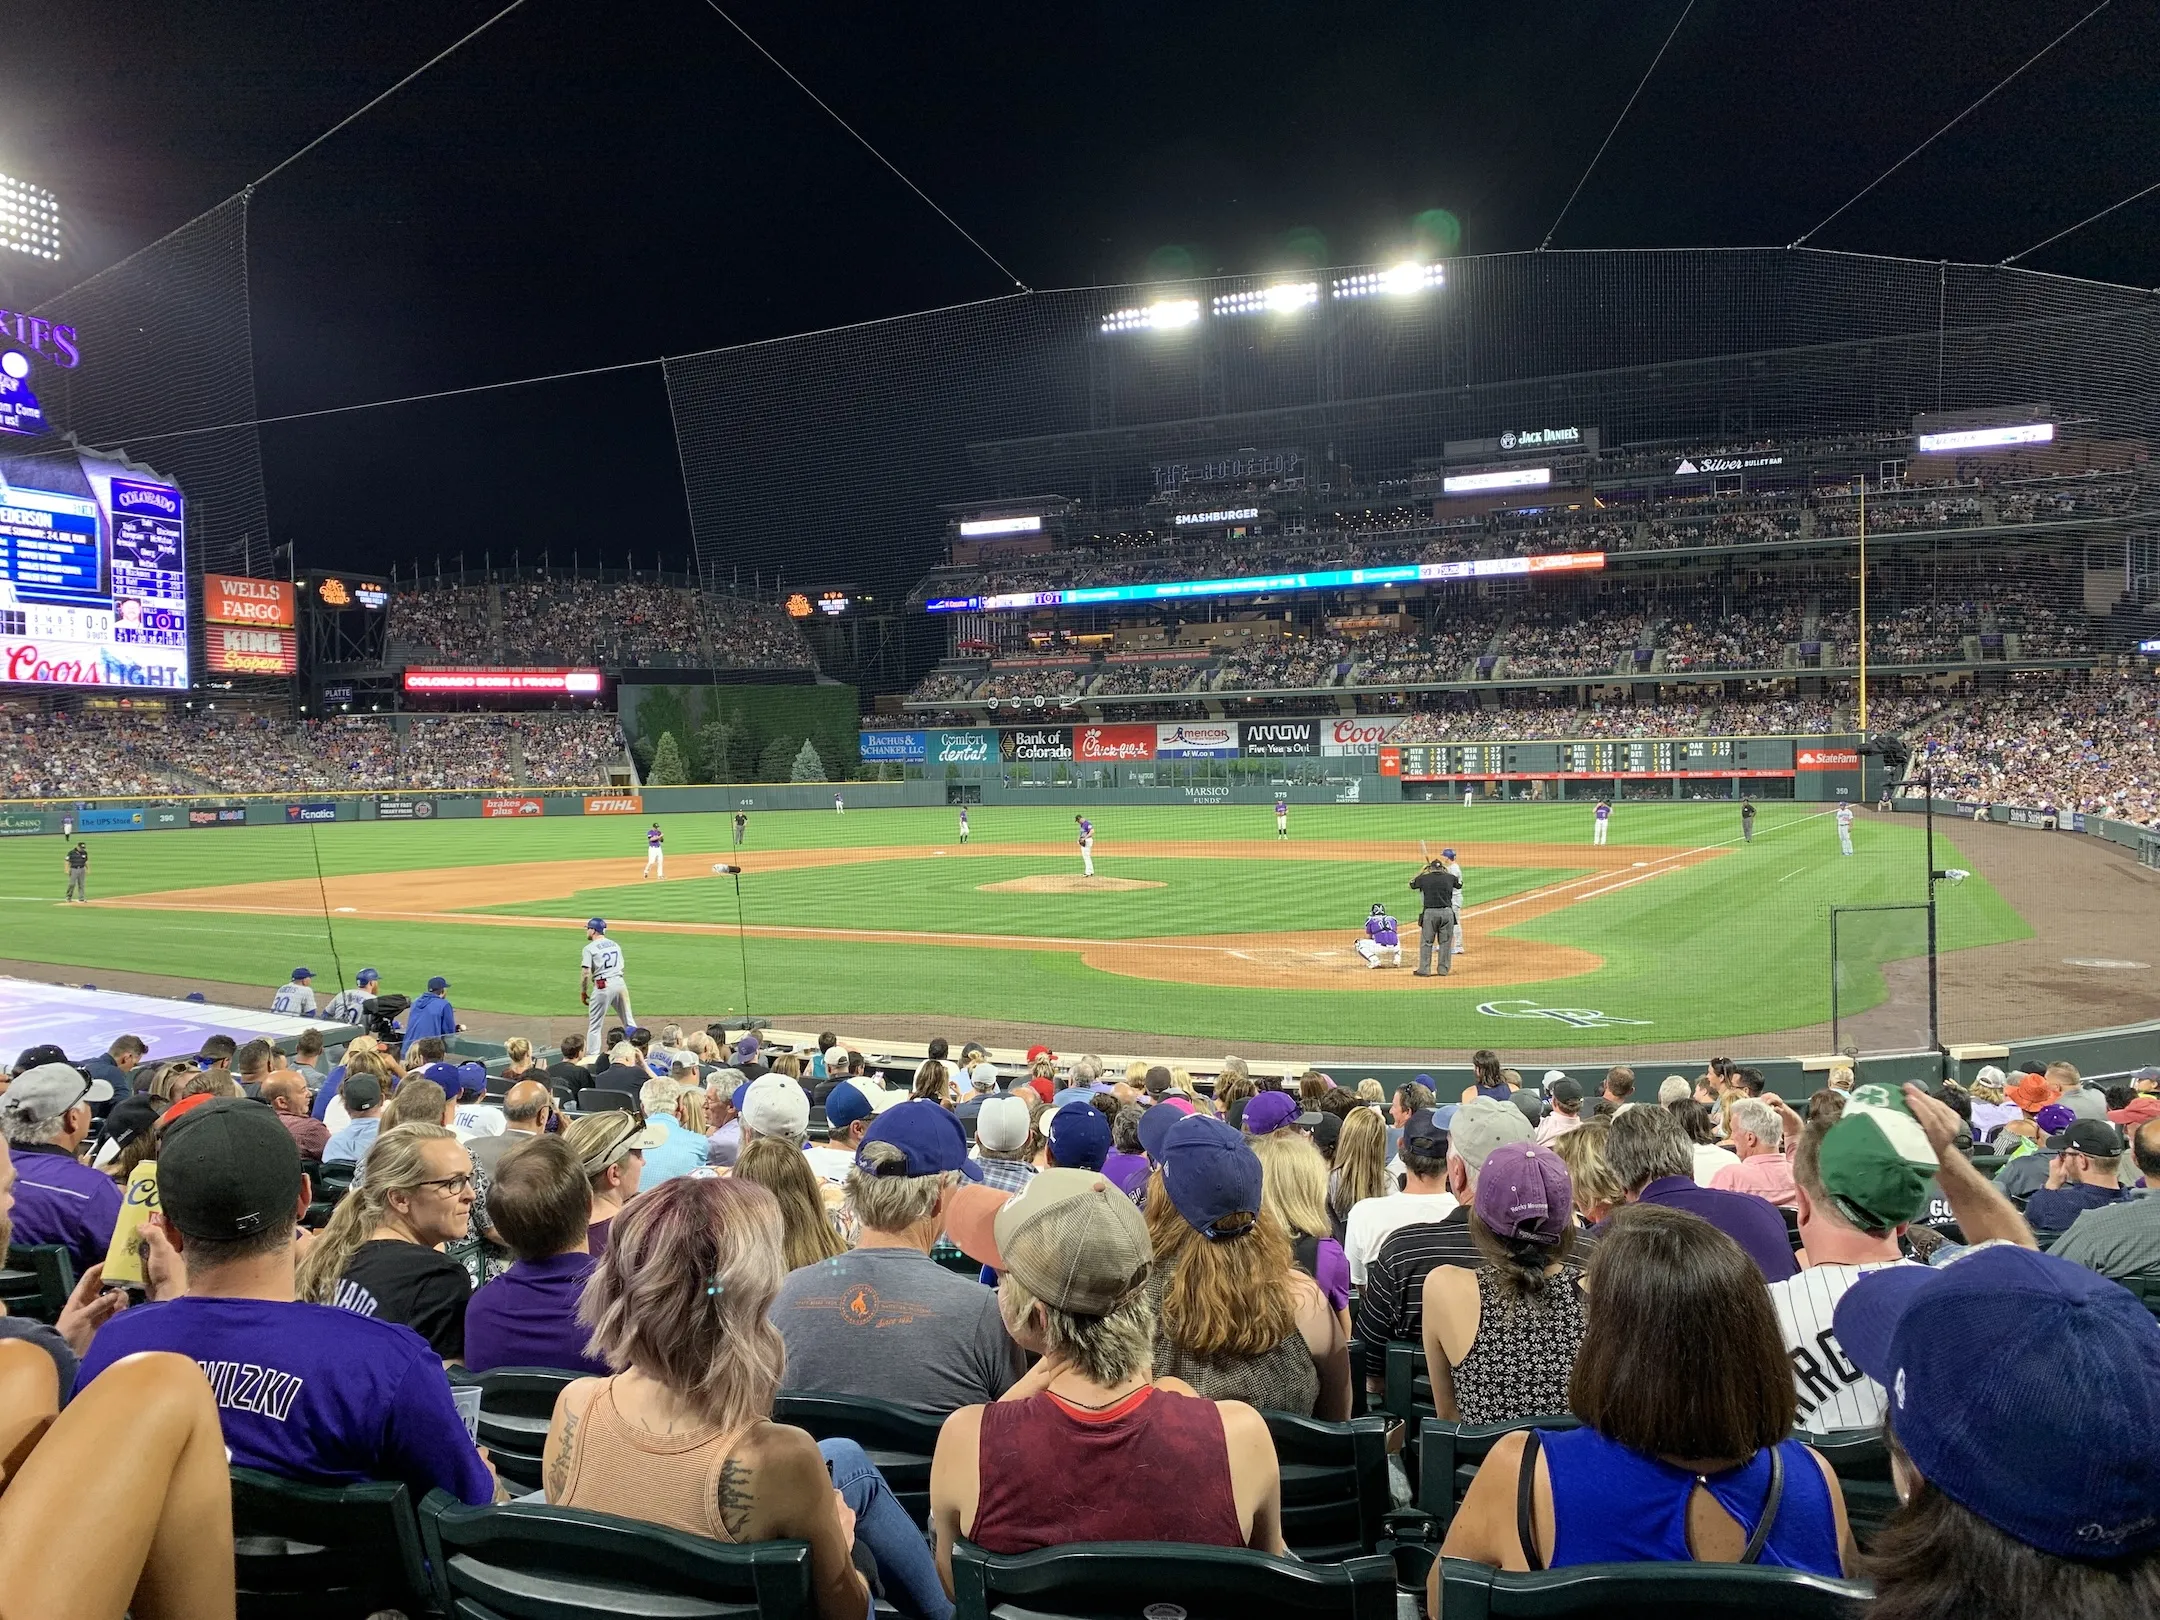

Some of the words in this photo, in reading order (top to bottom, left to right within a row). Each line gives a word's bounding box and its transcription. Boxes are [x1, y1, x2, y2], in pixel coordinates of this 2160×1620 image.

[1518, 431, 1542, 444] JACK
[1544, 427, 1578, 441] DANIEL'S
[1700, 458, 1743, 473] Silver
[1744, 459, 1769, 467] BULLET
[1770, 457, 1782, 465] BAR
[118, 490, 176, 513] COLORADO
[1175, 508, 1258, 525] SMASHBURGER
[220, 580, 280, 601] WELLS
[222, 601, 281, 621] FARGO
[223, 630, 283, 654] KING
[7, 645, 100, 684] Coors
[103, 661, 177, 687] LIGHT
[225, 651, 284, 671] Soopers
[408, 677, 475, 687] COLORADO
[325, 689, 351, 698] PLATTE
[1035, 698, 1043, 706] 17
[941, 732, 985, 746] Comfort
[1016, 731, 1046, 745] Bank
[1048, 730, 1062, 744] of
[1248, 724, 1311, 741] ARROW
[868, 735, 904, 746] BACHUS
[905, 735, 916, 745] &
[1083, 735, 1149, 759] Chick-fil-A
[860, 744, 907, 755] SCHANKER
[908, 746, 924, 754] LLC
[1016, 744, 1072, 758] Colorado
[1248, 744, 1265, 753] Five
[1293, 743, 1310, 753] Out
[1345, 744, 1377, 755] LIGH
[1185, 787, 1229, 796] MARSICO
[486, 799, 520, 808] brakes
[589, 800, 637, 811] STIHL
[160, 814, 174, 822] 390
[190, 812, 216, 824] Exxon
[219, 810, 245, 820] Mobil
[301, 809, 335, 819] Fanatics
[492, 808, 513, 816] plus
[5, 816, 41, 827] CASINO
[602, 951, 618, 969] 27
[455, 1112, 478, 1129] THE
[127, 1179, 161, 1208] Co
[1510, 1203, 1527, 1213] Rocky
[334, 1278, 378, 1318] NADO
[197, 1360, 303, 1422] WIZKI
